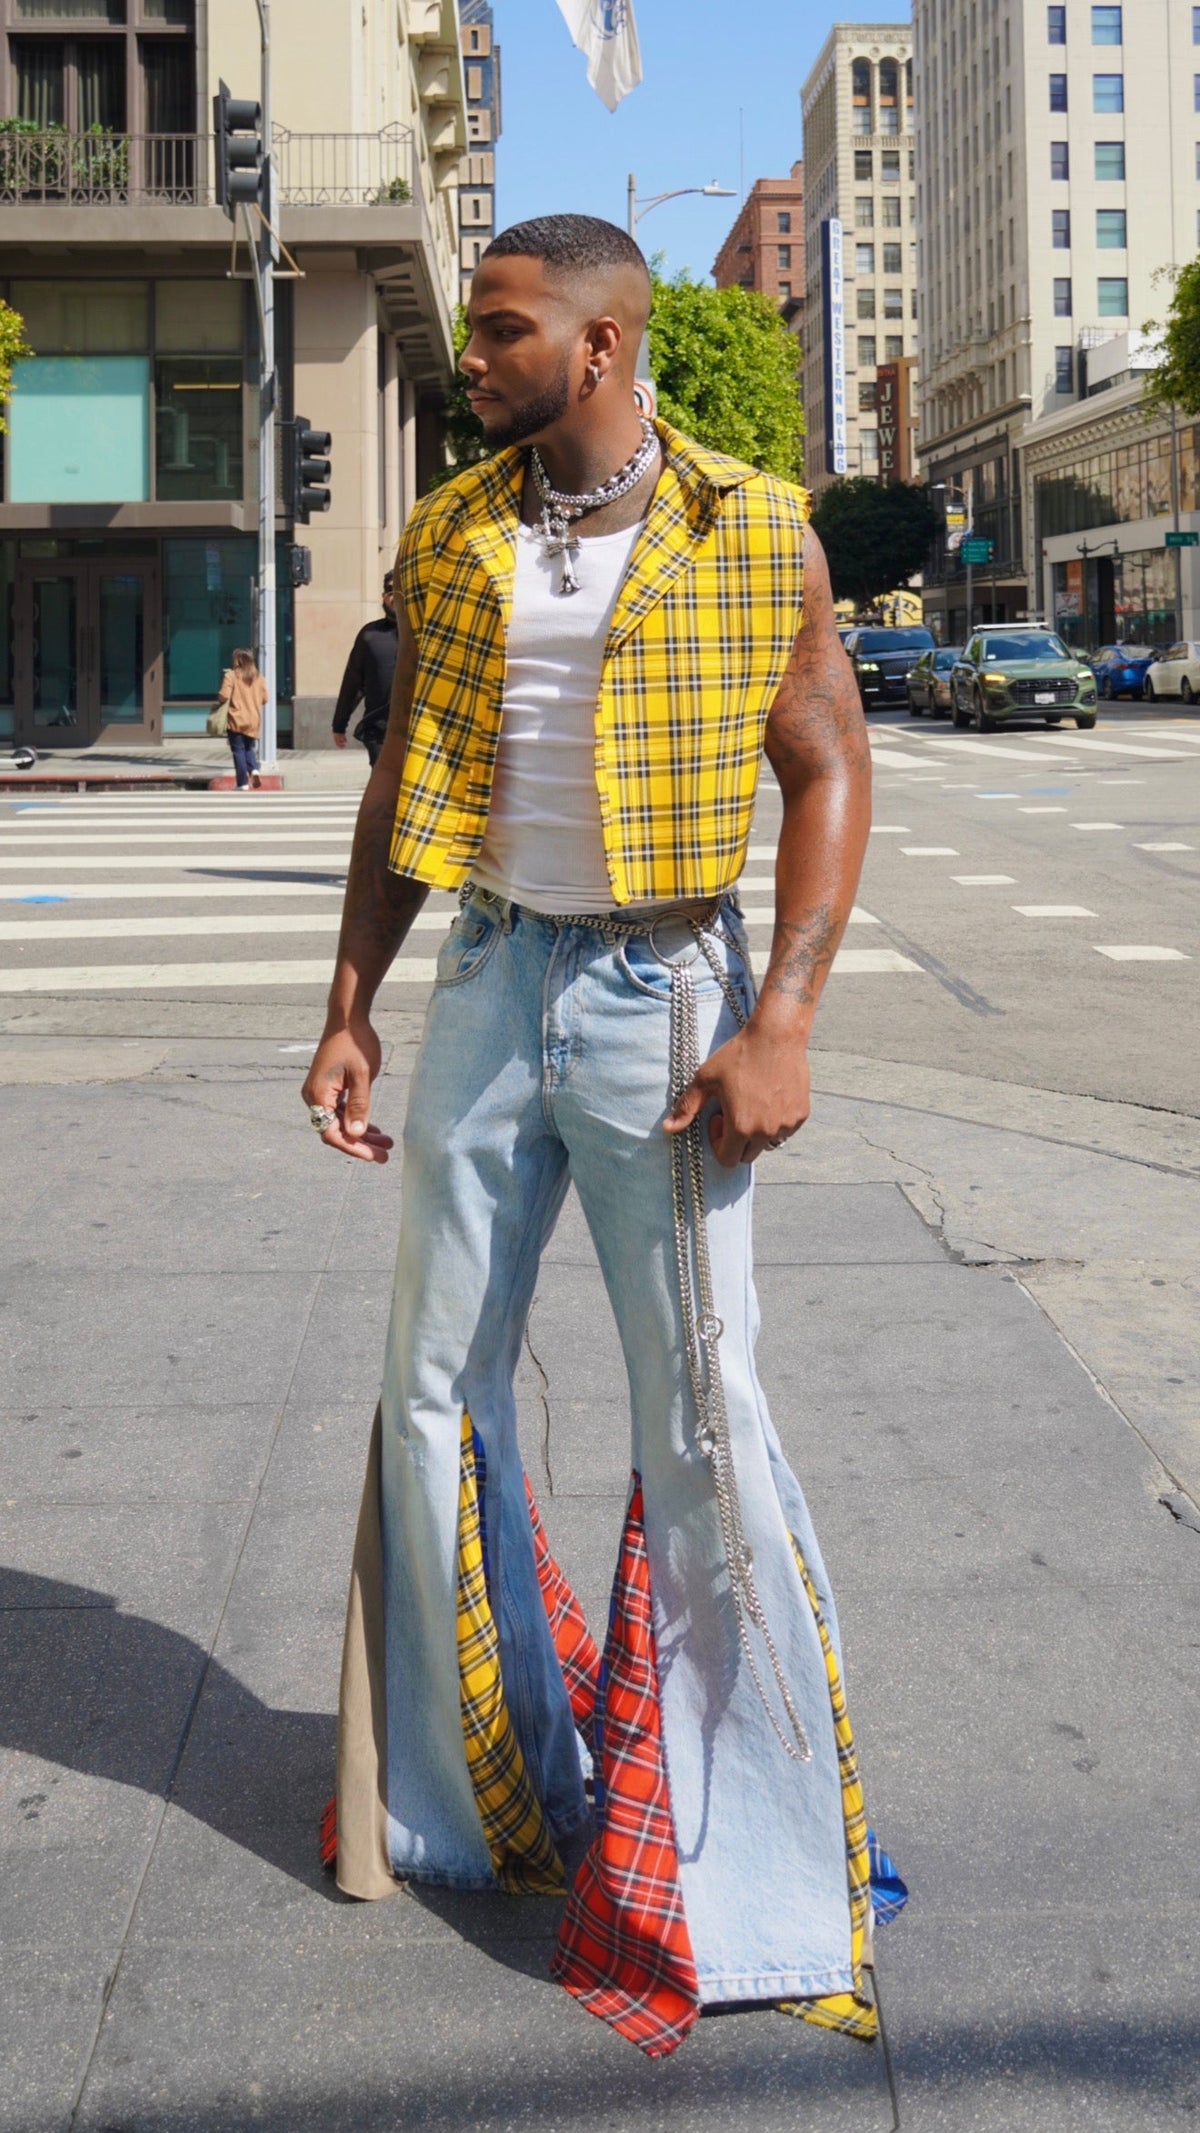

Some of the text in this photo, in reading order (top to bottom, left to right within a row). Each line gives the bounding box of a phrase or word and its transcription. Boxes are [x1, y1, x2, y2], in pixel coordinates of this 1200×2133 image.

[832, 221, 845, 471] GREAT WESTERN BLDG
